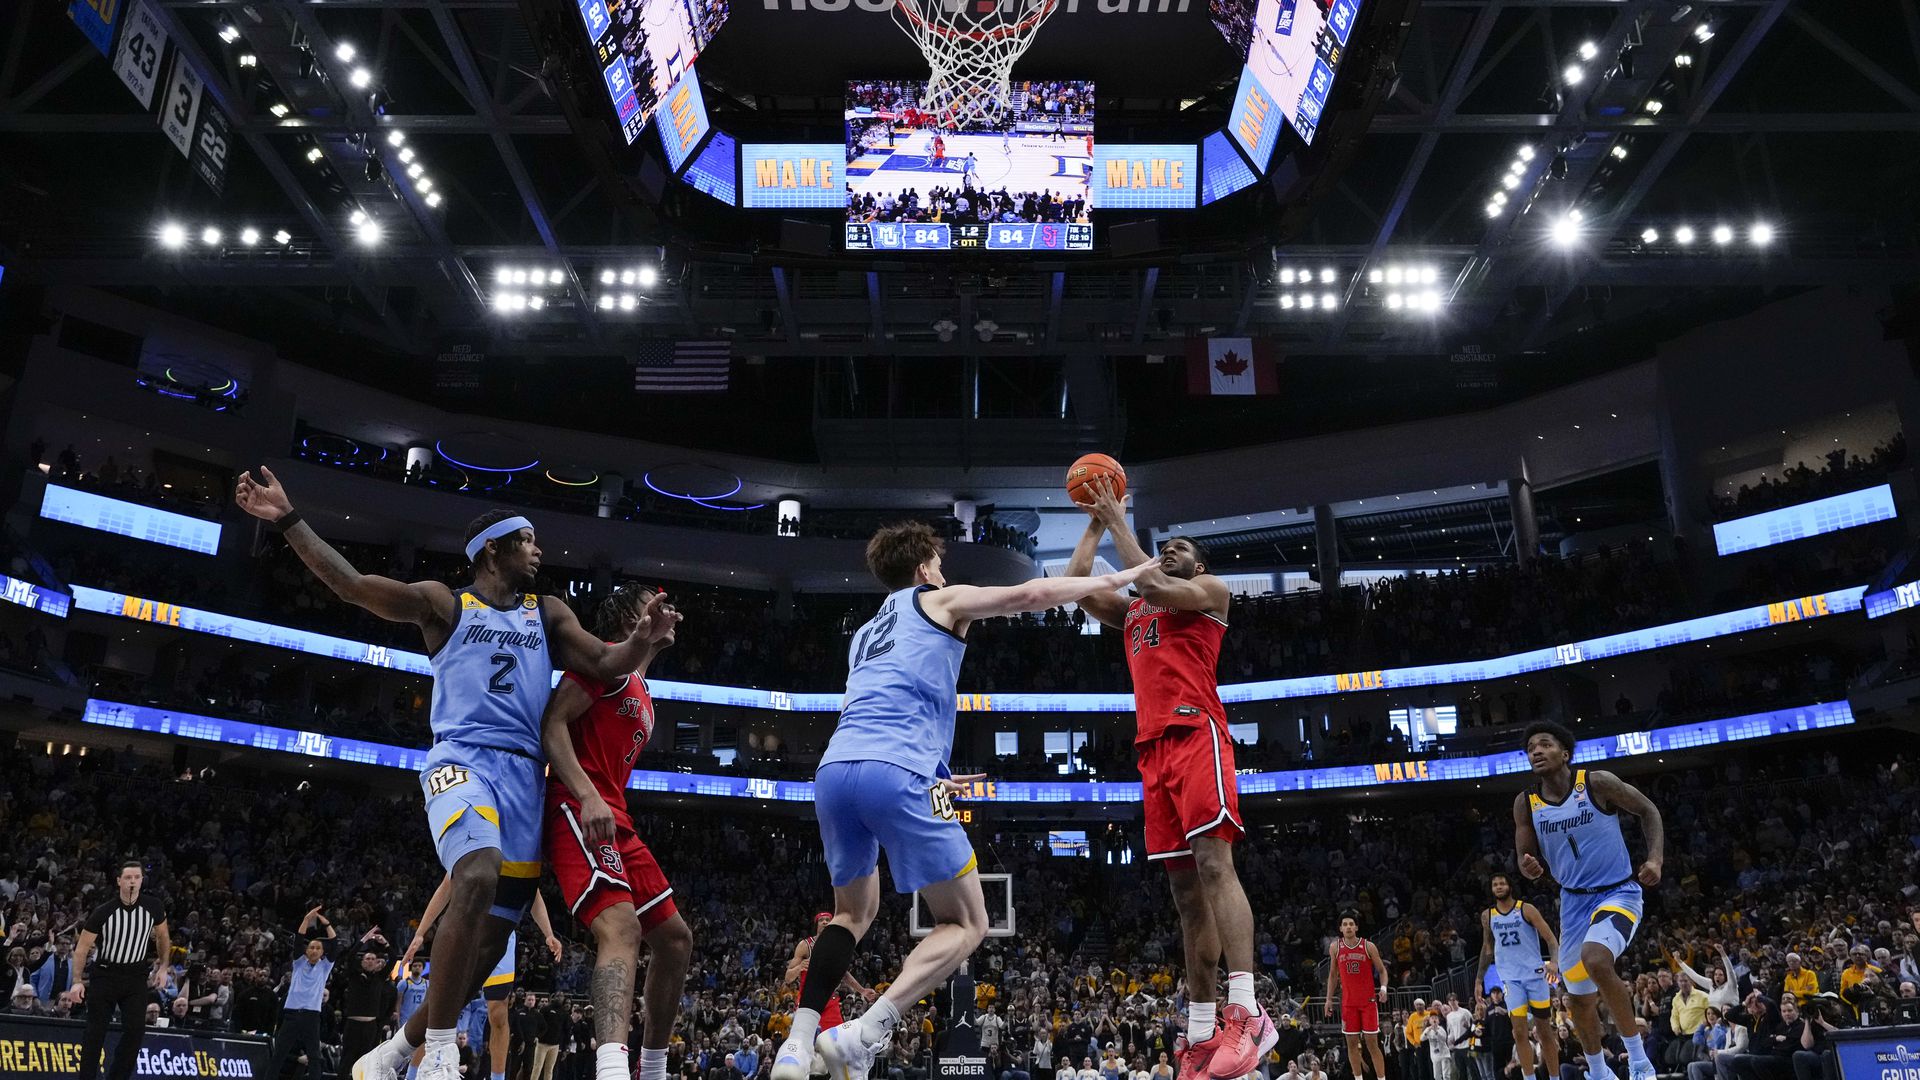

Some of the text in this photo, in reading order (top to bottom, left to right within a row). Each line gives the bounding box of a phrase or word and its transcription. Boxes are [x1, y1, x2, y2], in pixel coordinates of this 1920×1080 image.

[587, 1, 604, 29] 84
[1334, 3, 1350, 30] 84
[128, 32, 156, 79] 43
[611, 67, 626, 93] 84
[1312, 68, 1327, 93] 84
[174, 84, 193, 128] 3
[670, 84, 699, 153] MAKE
[1238, 85, 1269, 151] MAKE
[200, 122, 227, 171] 22
[755, 158, 834, 189] MAKE
[1105, 158, 1184, 190] MAKE
[915, 229, 940, 244] 84
[960, 226, 979, 237] 1.2
[999, 229, 1024, 244] 84
[1894, 580, 1920, 609] M
[122, 595, 181, 627] MAKE
[1767, 595, 1830, 624] MAKE
[463, 624, 543, 652] Marquette
[854, 612, 898, 669] 12
[1131, 617, 1160, 657] 24
[488, 653, 518, 694] 2
[1336, 669, 1383, 691] MAKE
[1374, 760, 1429, 781] MAKE
[960, 782, 997, 799] AKE
[1537, 809, 1594, 836] Marquette
[1567, 833, 1582, 861] 1
[1499, 930, 1521, 947] 23
[1345, 961, 1361, 975] 12
[412, 994, 422, 1005] 13
[136, 1047, 254, 1078] HeGetsUs.com
[941, 1065, 985, 1076] GRUBER
[1881, 1068, 1920, 1080] GRUB
